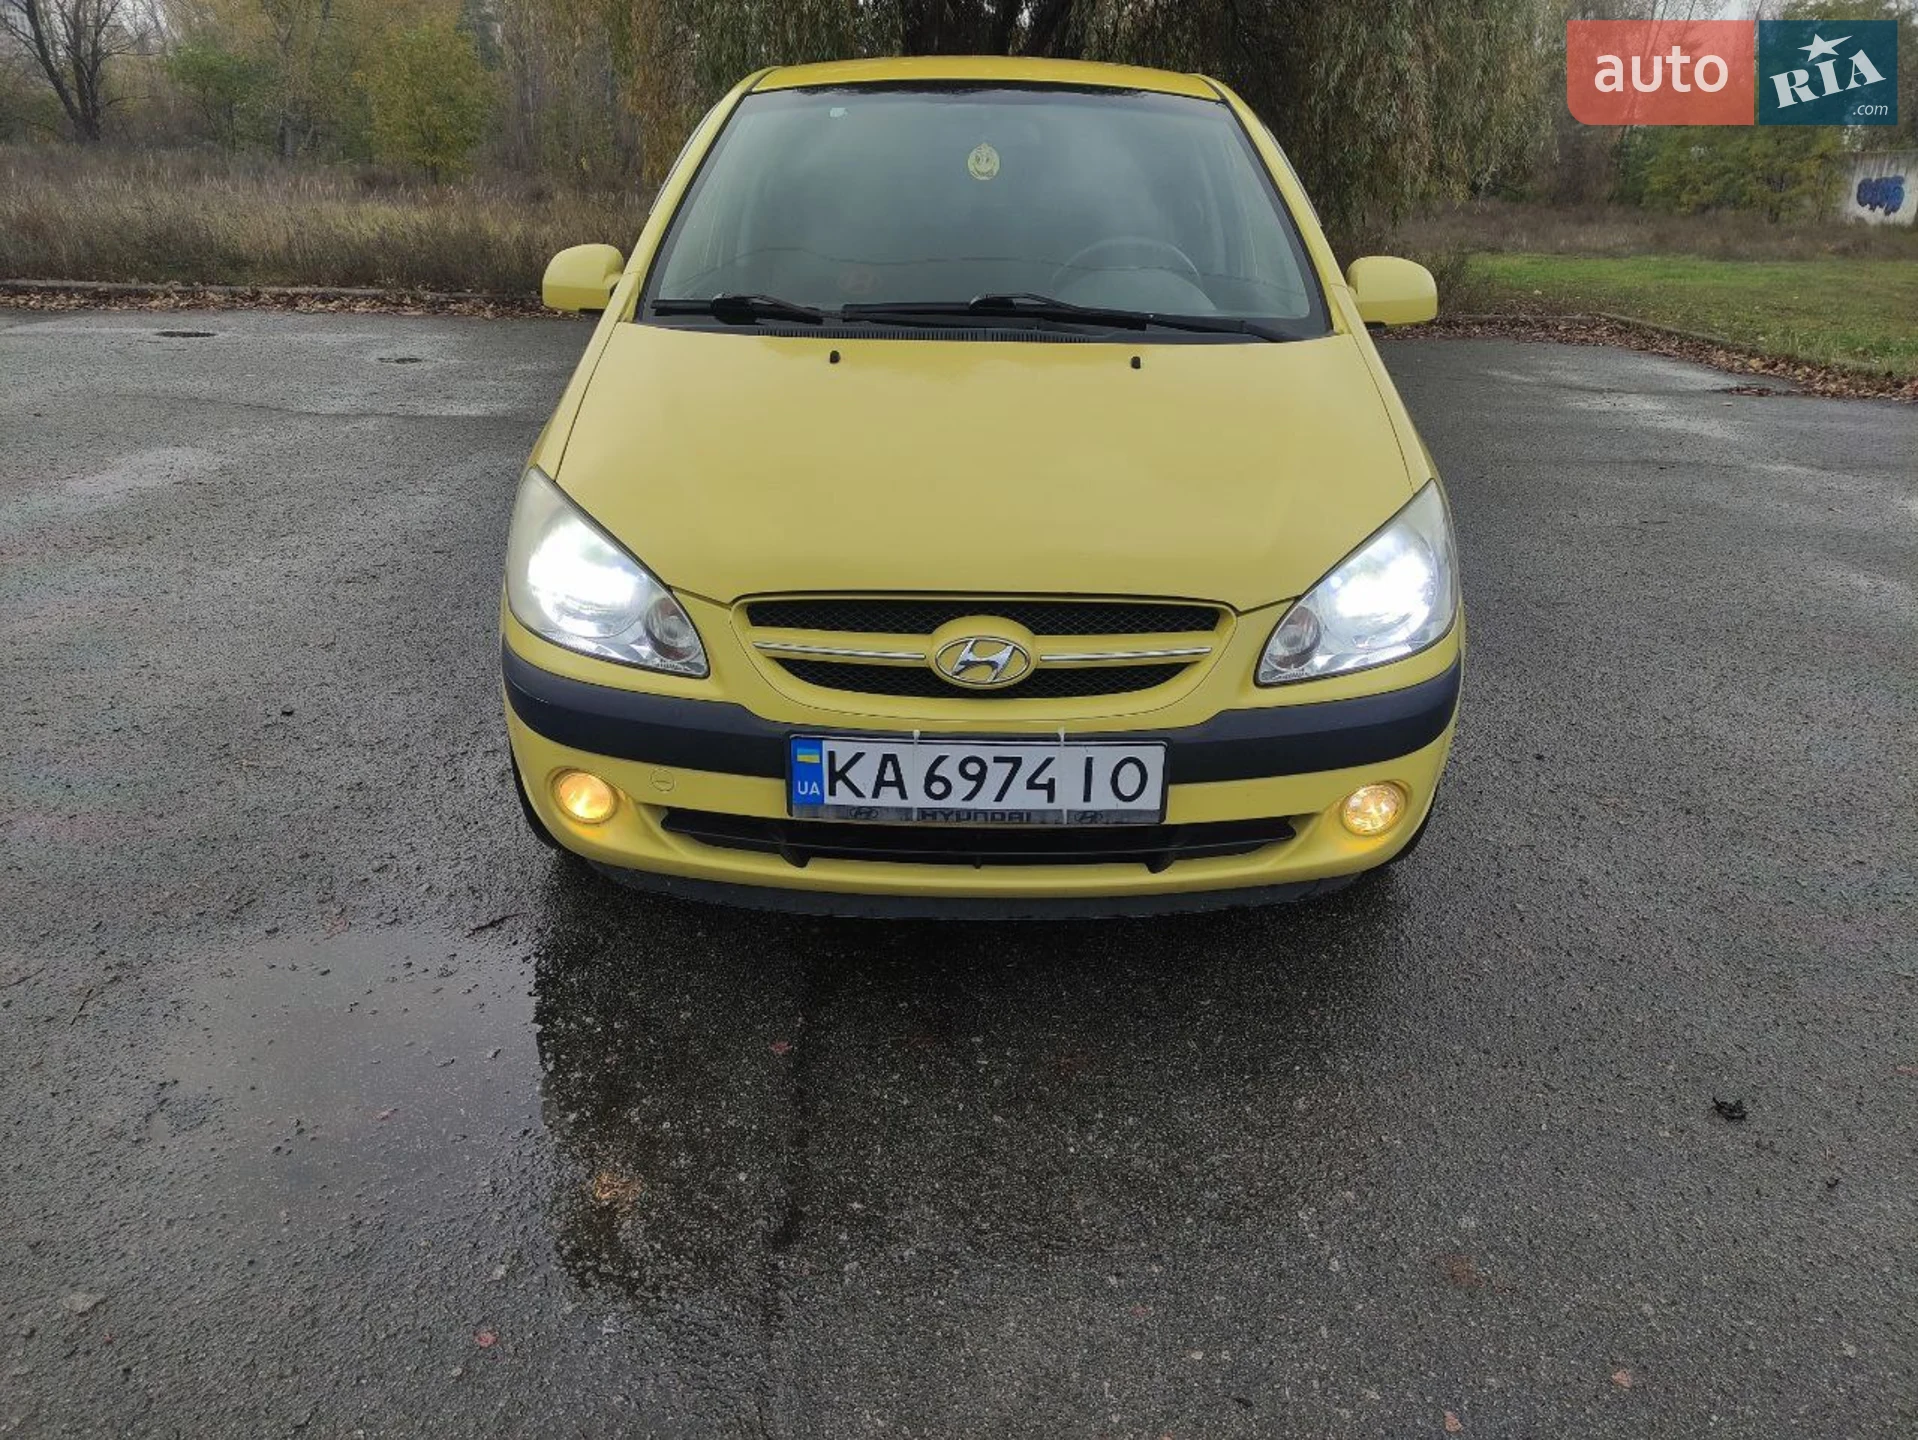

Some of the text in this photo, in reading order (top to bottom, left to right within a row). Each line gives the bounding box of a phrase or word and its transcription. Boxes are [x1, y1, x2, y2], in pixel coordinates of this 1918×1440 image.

[827, 750, 1149, 803] KA 6974 IO
[797, 782, 821, 797] UA
[920, 809, 1033, 823] HYUNDAI
